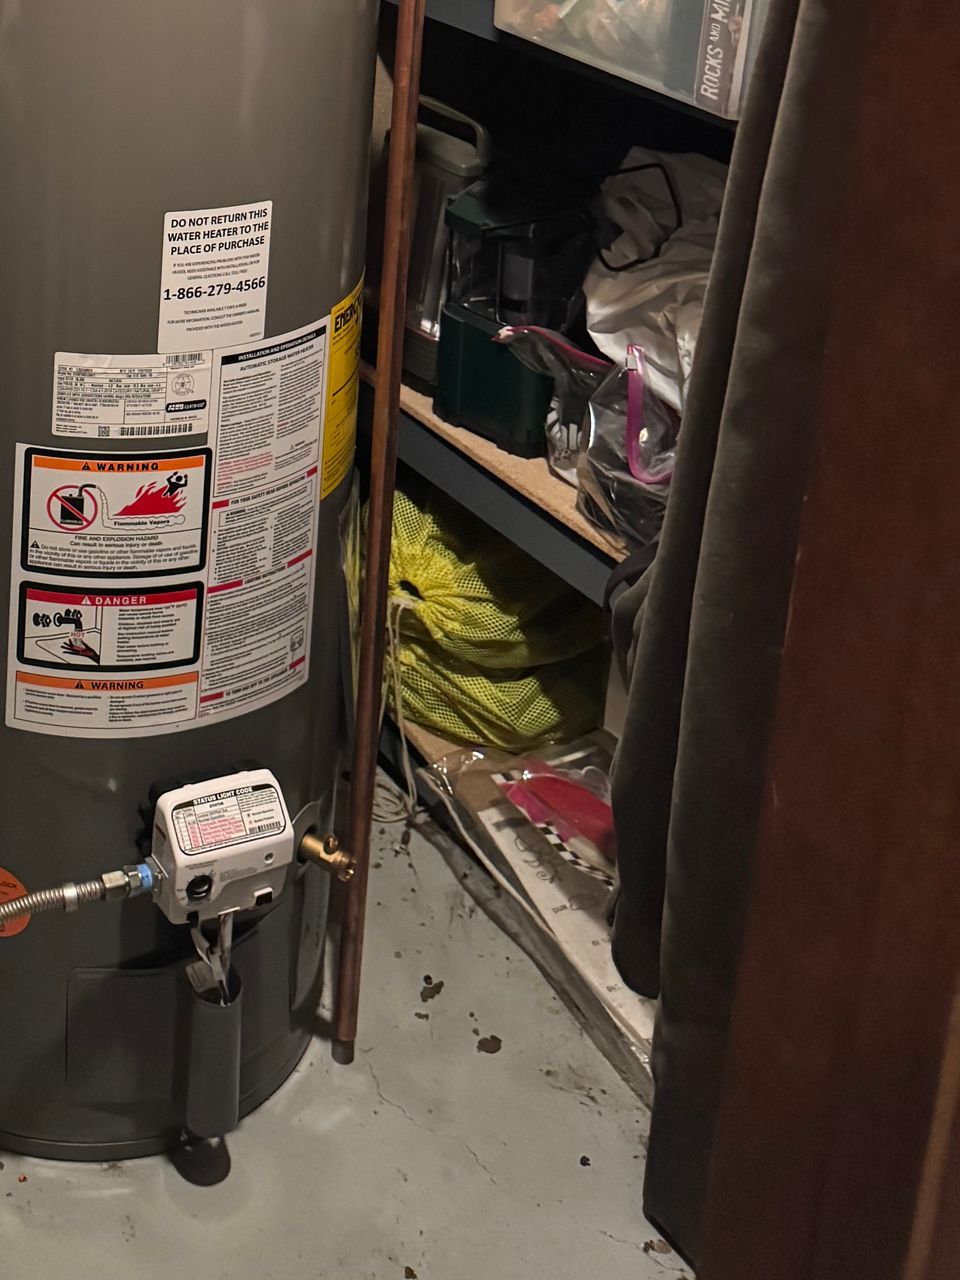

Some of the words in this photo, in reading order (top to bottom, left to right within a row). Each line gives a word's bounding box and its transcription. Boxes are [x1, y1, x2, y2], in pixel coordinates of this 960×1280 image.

[710, 24, 720, 42] AND
[700, 45, 724, 100] ROCKS
[171, 219, 186, 228] DO
[188, 216, 209, 227] NOT
[211, 212, 247, 225] RETURN
[249, 208, 267, 220] THIS
[168, 232, 201, 242] WATER
[203, 227, 238, 239] HEATER
[240, 225, 251, 234] TO
[253, 222, 269, 232] THE
[171, 246, 201, 255] PLACE
[204, 243, 216, 253] OF
[218, 236, 264, 251] PURCHASE
[164, 276, 265, 300] 1-866-279-4566
[238, 348, 270, 360] INSTALLATION
[270, 346, 280, 354] AND
[240, 360, 267, 371] AUTOMATIC
[97, 463, 158, 471] WARNING
[95, 597, 146, 605] DANGER
[91, 681, 144, 690] WARNING
[193, 796, 216, 805] STATUS
[236, 787, 253, 795] CODE
